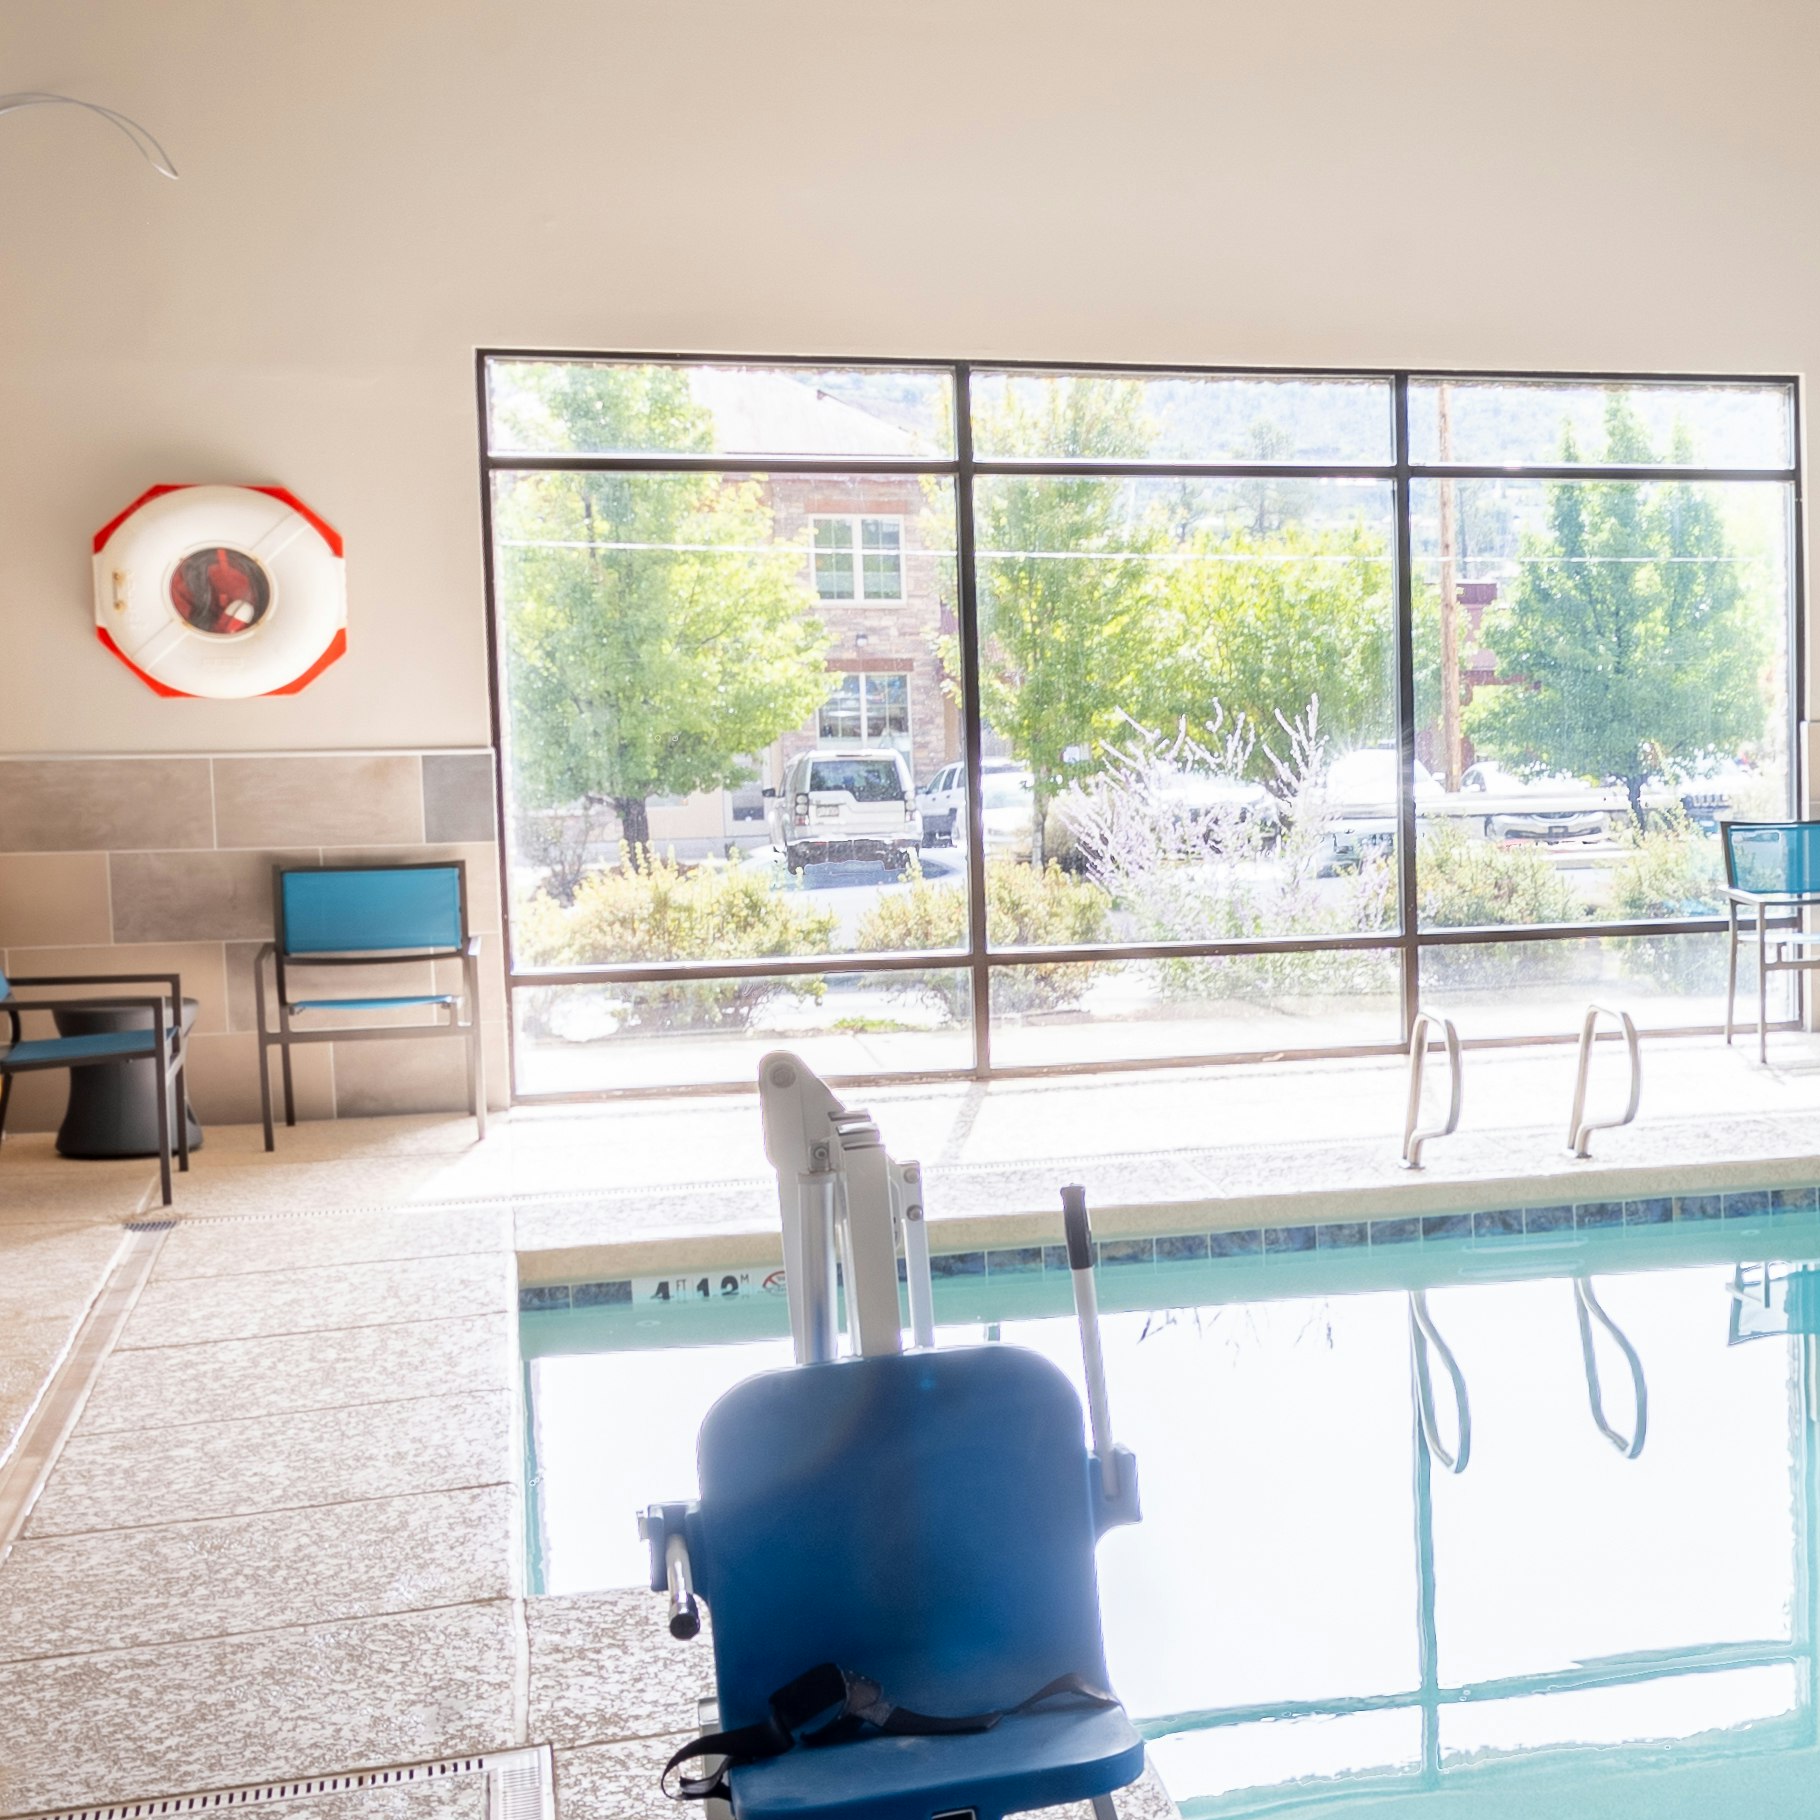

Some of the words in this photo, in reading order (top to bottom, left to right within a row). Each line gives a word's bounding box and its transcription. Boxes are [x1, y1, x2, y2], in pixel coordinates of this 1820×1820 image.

[650, 1280, 674, 1301] 4
[676, 1278, 687, 1293] FT
[740, 1273, 750, 1285] M
